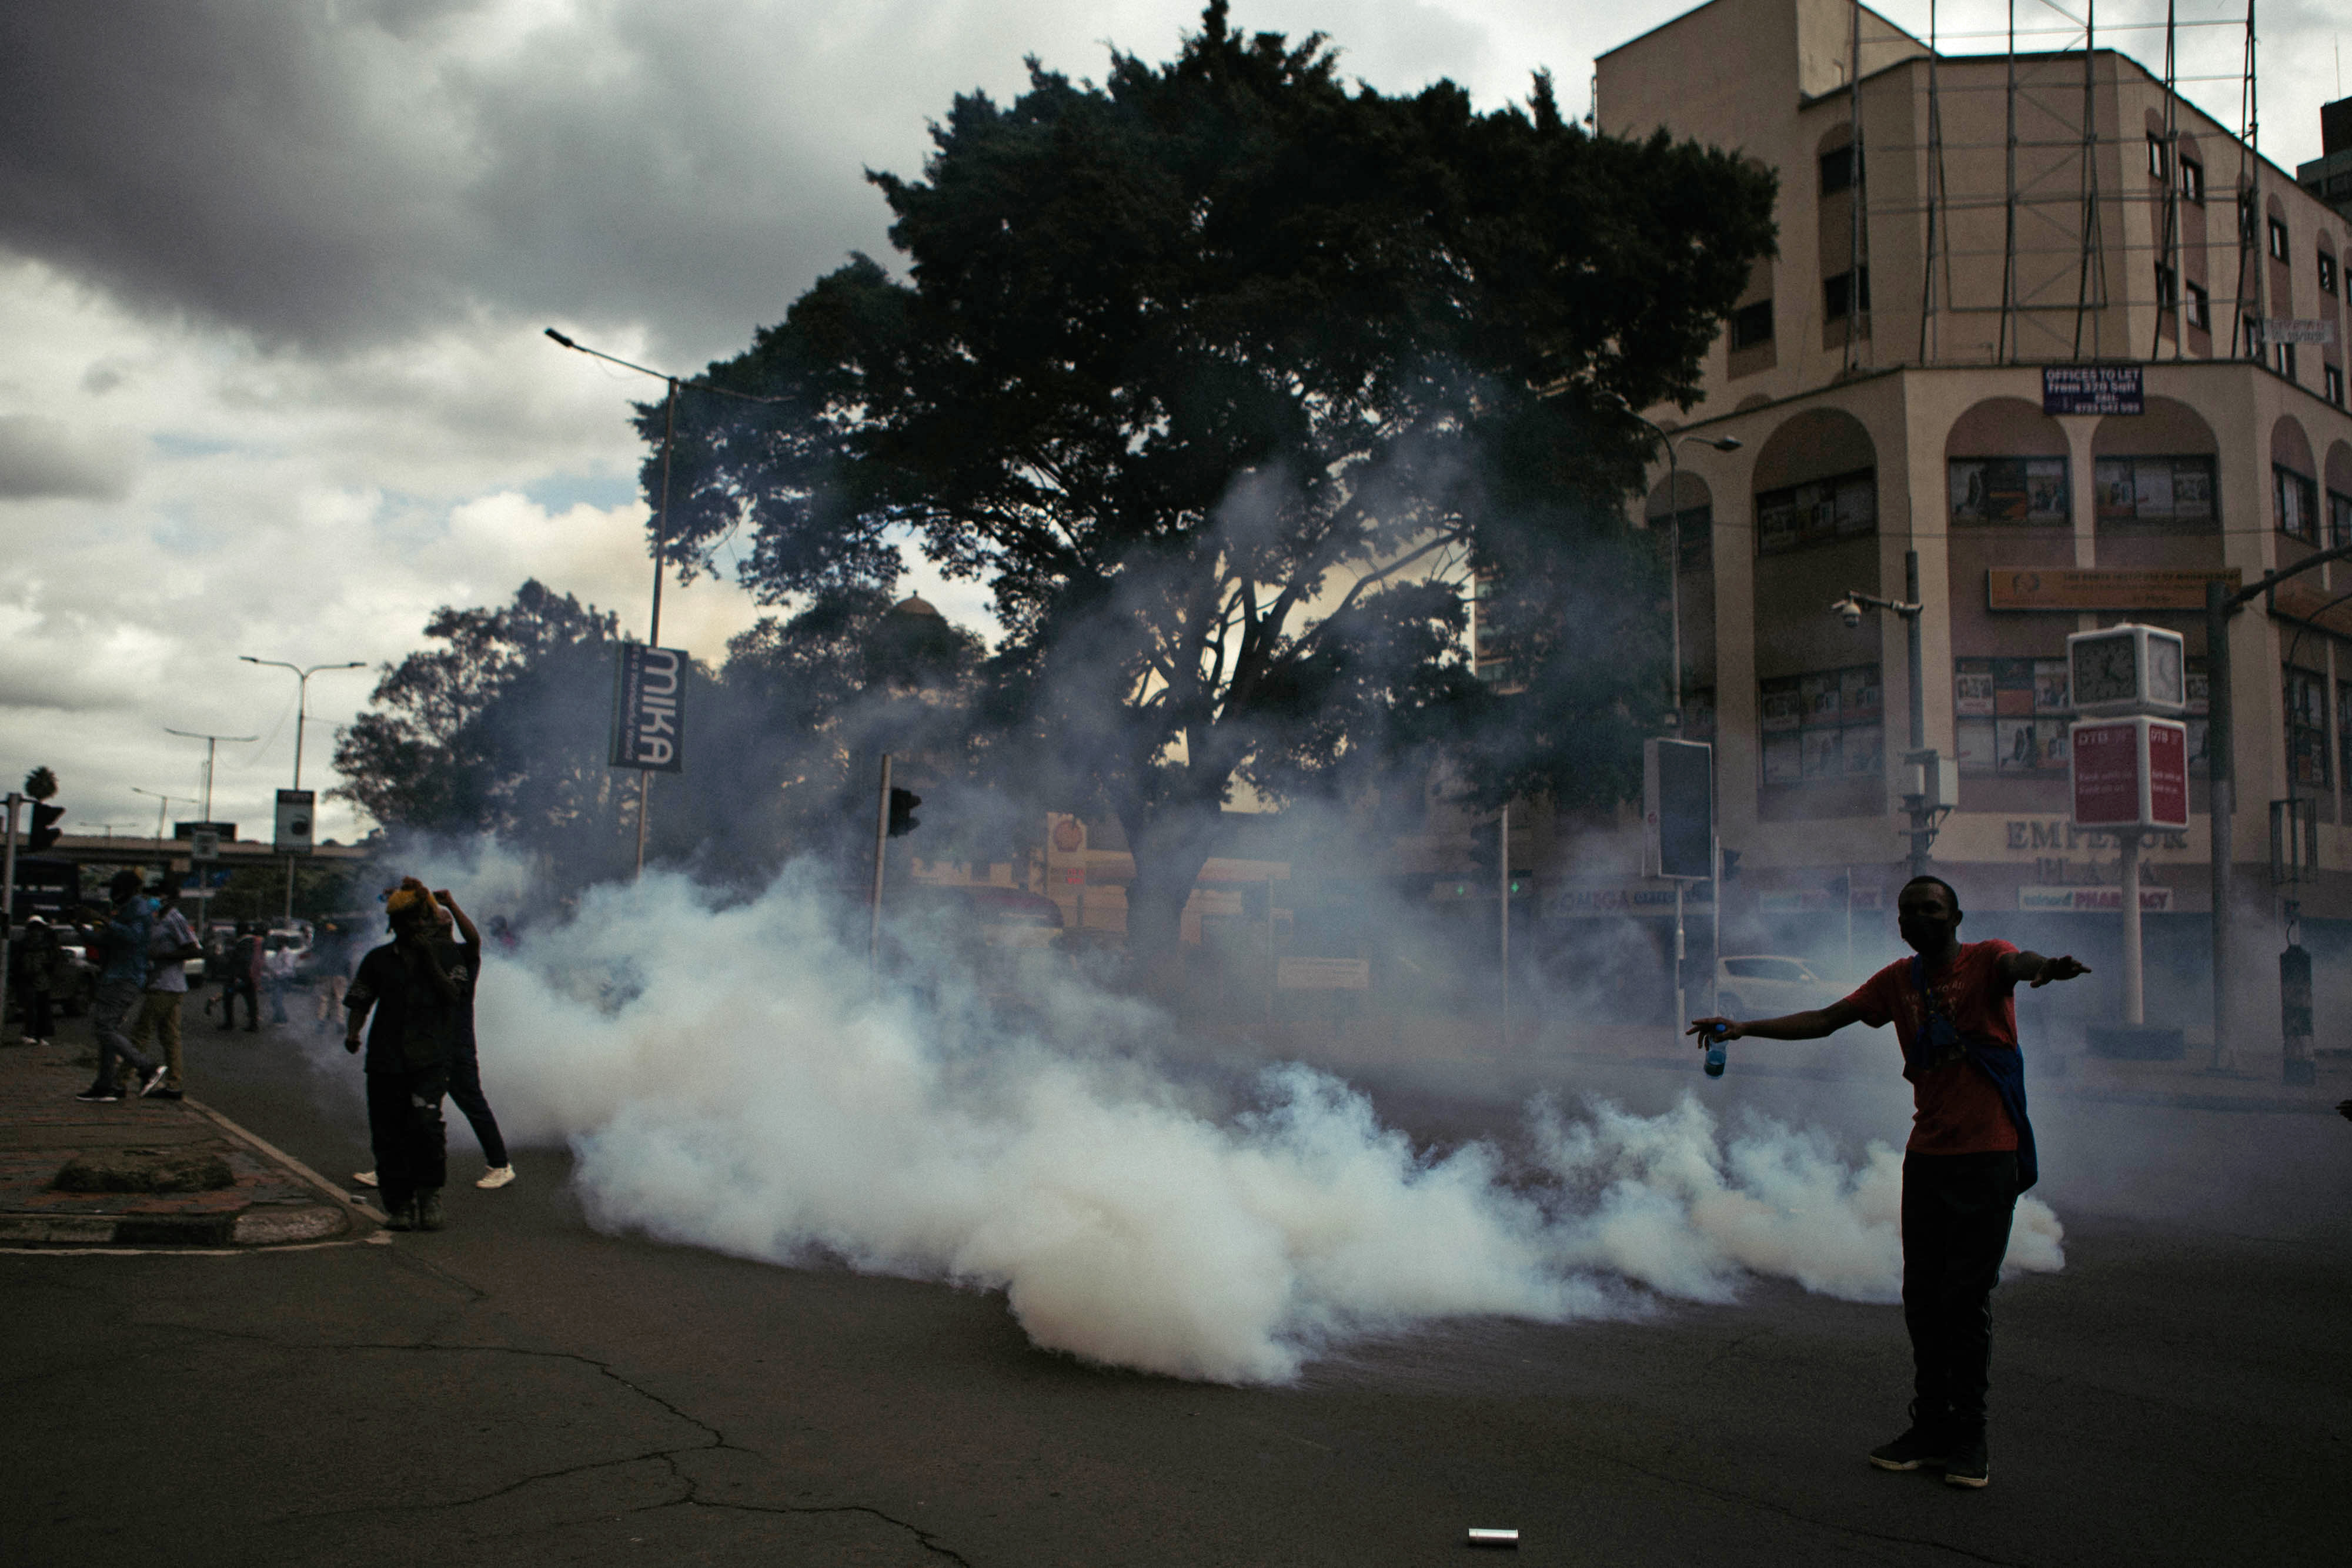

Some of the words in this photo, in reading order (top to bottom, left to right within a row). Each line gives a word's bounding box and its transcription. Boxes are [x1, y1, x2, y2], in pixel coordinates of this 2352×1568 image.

[2046, 369, 2097, 380] OFFICES
[2100, 369, 2116, 380] TO
[2118, 368, 2140, 380] LET
[2075, 891, 2168, 908] PHARACY
